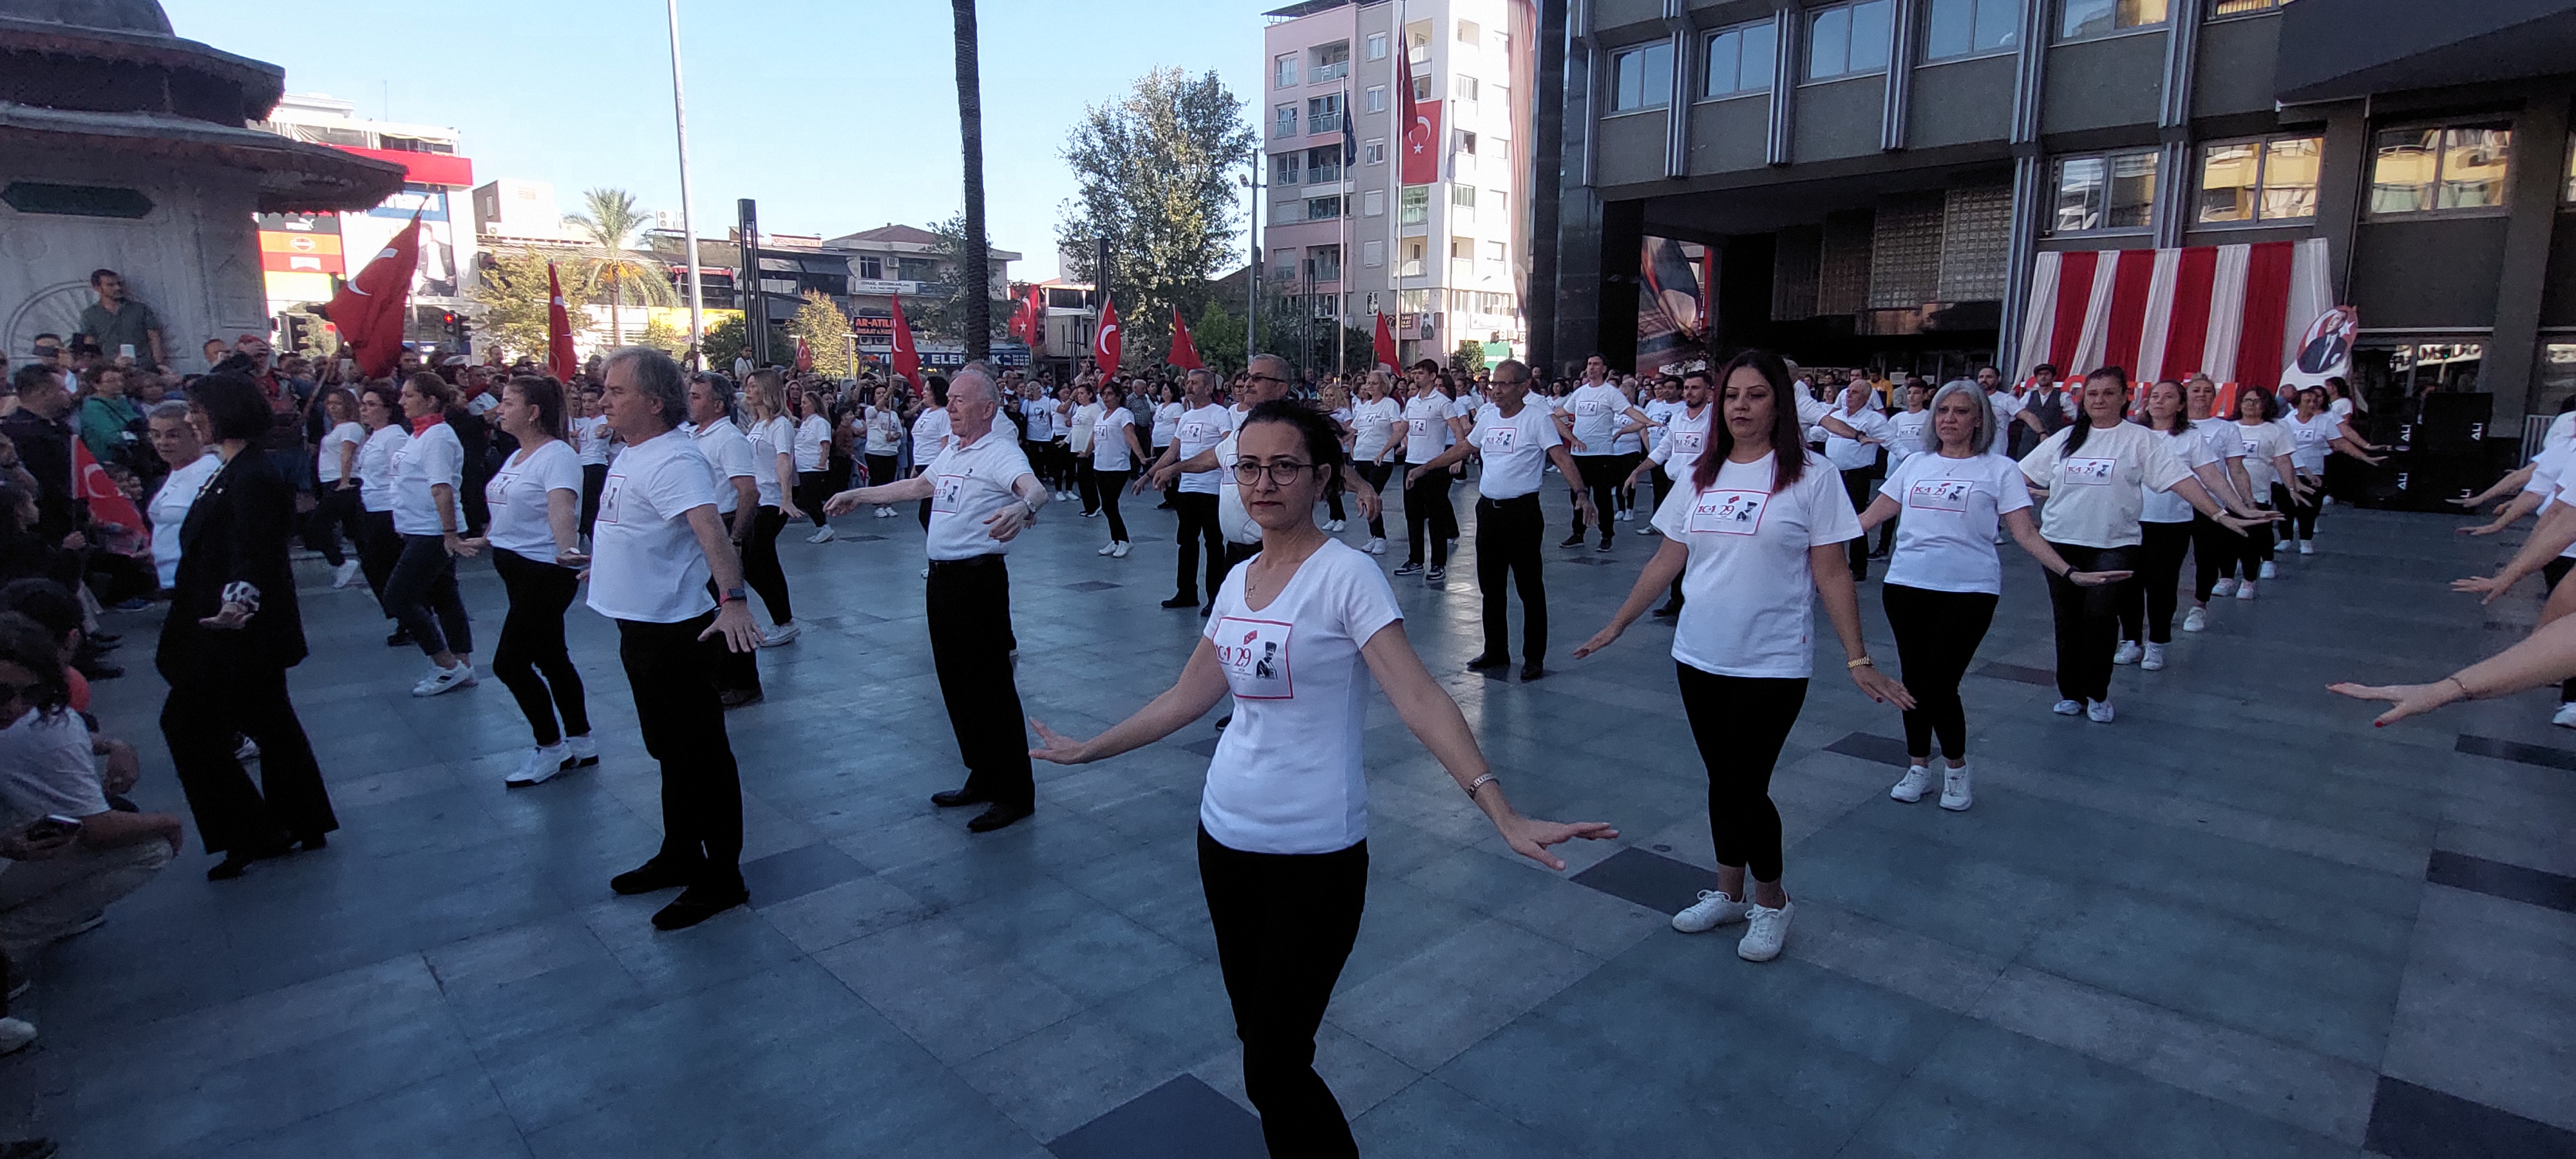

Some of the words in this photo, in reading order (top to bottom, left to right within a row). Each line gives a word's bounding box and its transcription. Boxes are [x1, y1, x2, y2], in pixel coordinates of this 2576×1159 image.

[2401, 424, 2412, 442] ALI
[2471, 422, 2483, 440] ALI
[2397, 473, 2408, 490] ALI
[1719, 505, 1735, 516] 29
[1234, 647, 1252, 668] 29
